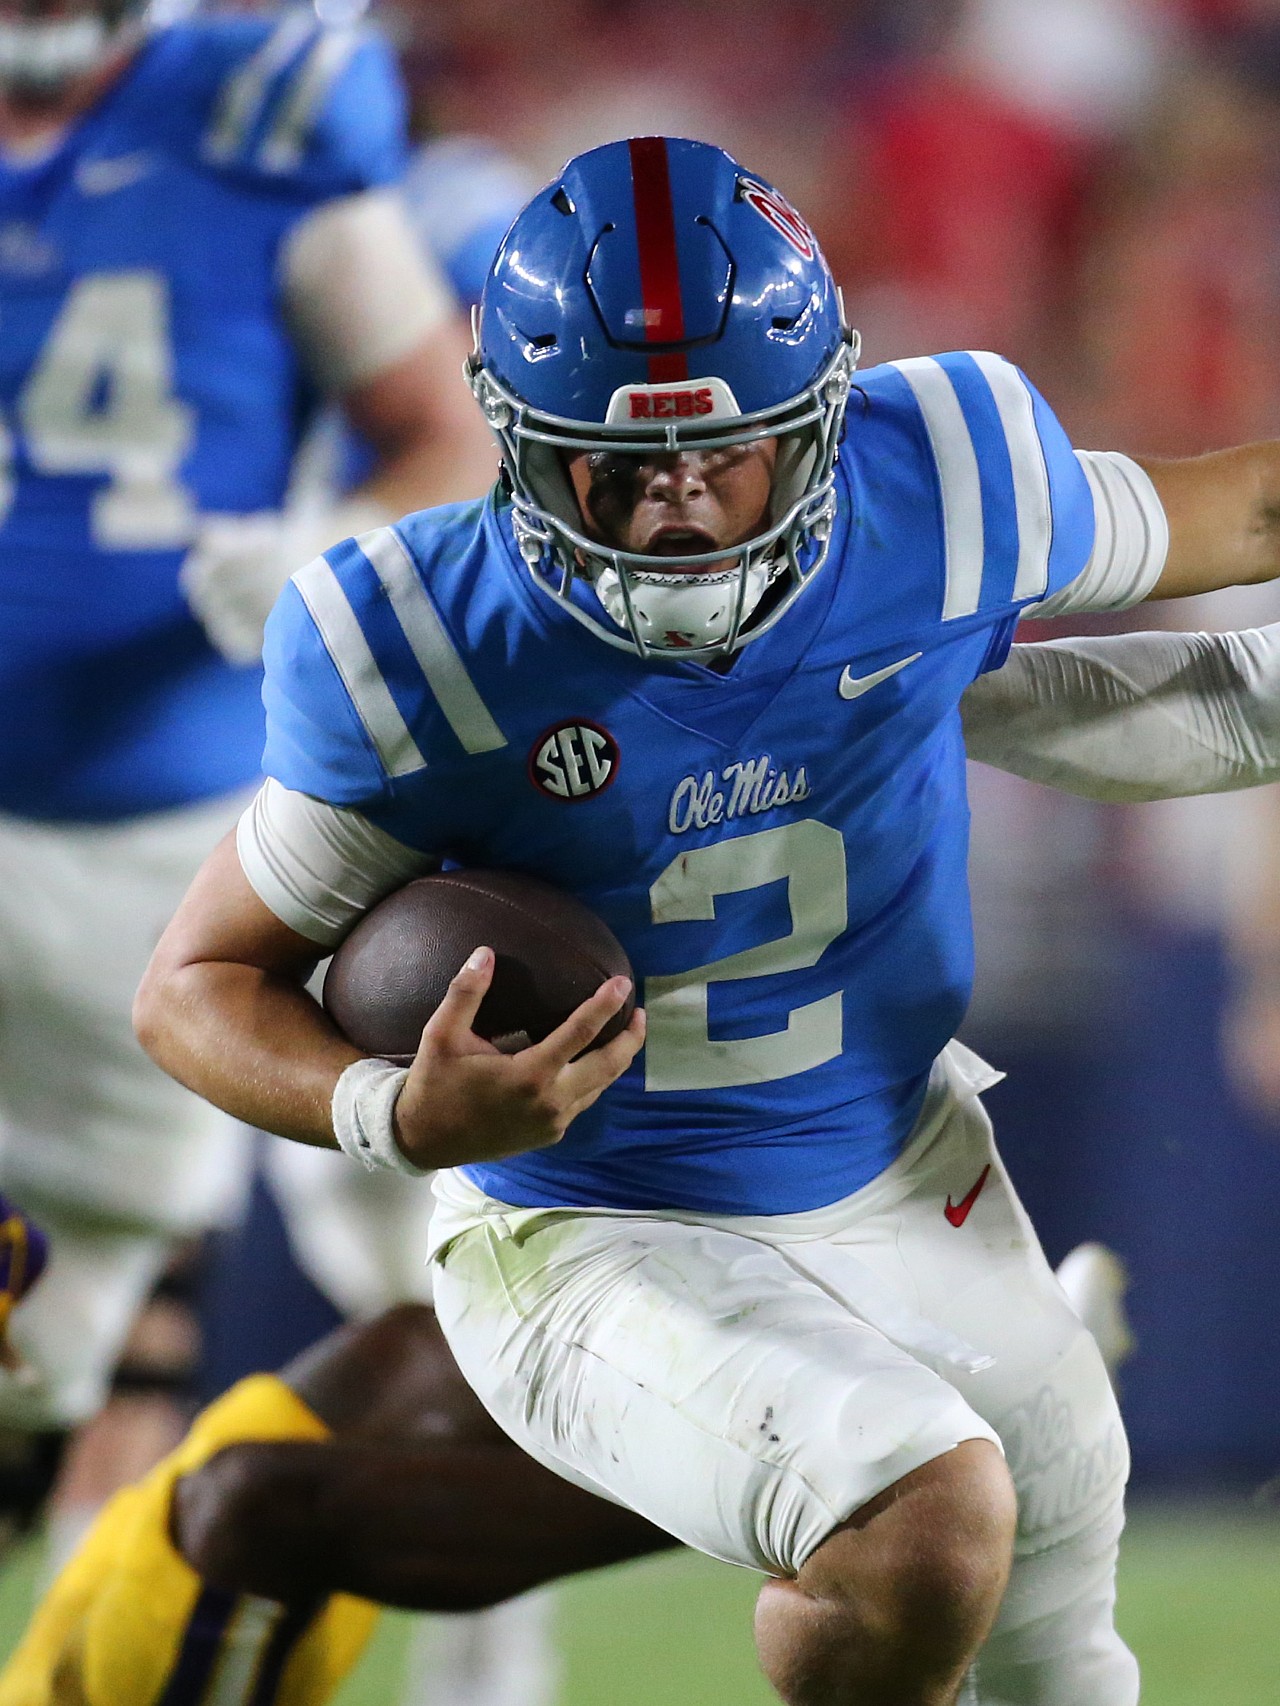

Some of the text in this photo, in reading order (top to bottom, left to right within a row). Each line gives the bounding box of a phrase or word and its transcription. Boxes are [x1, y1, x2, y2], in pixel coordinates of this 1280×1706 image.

[629, 388, 713, 418] REBS
[536, 726, 611, 797] SEC
[668, 754, 812, 834] Ole Miss
[644, 818, 848, 1092] 2
